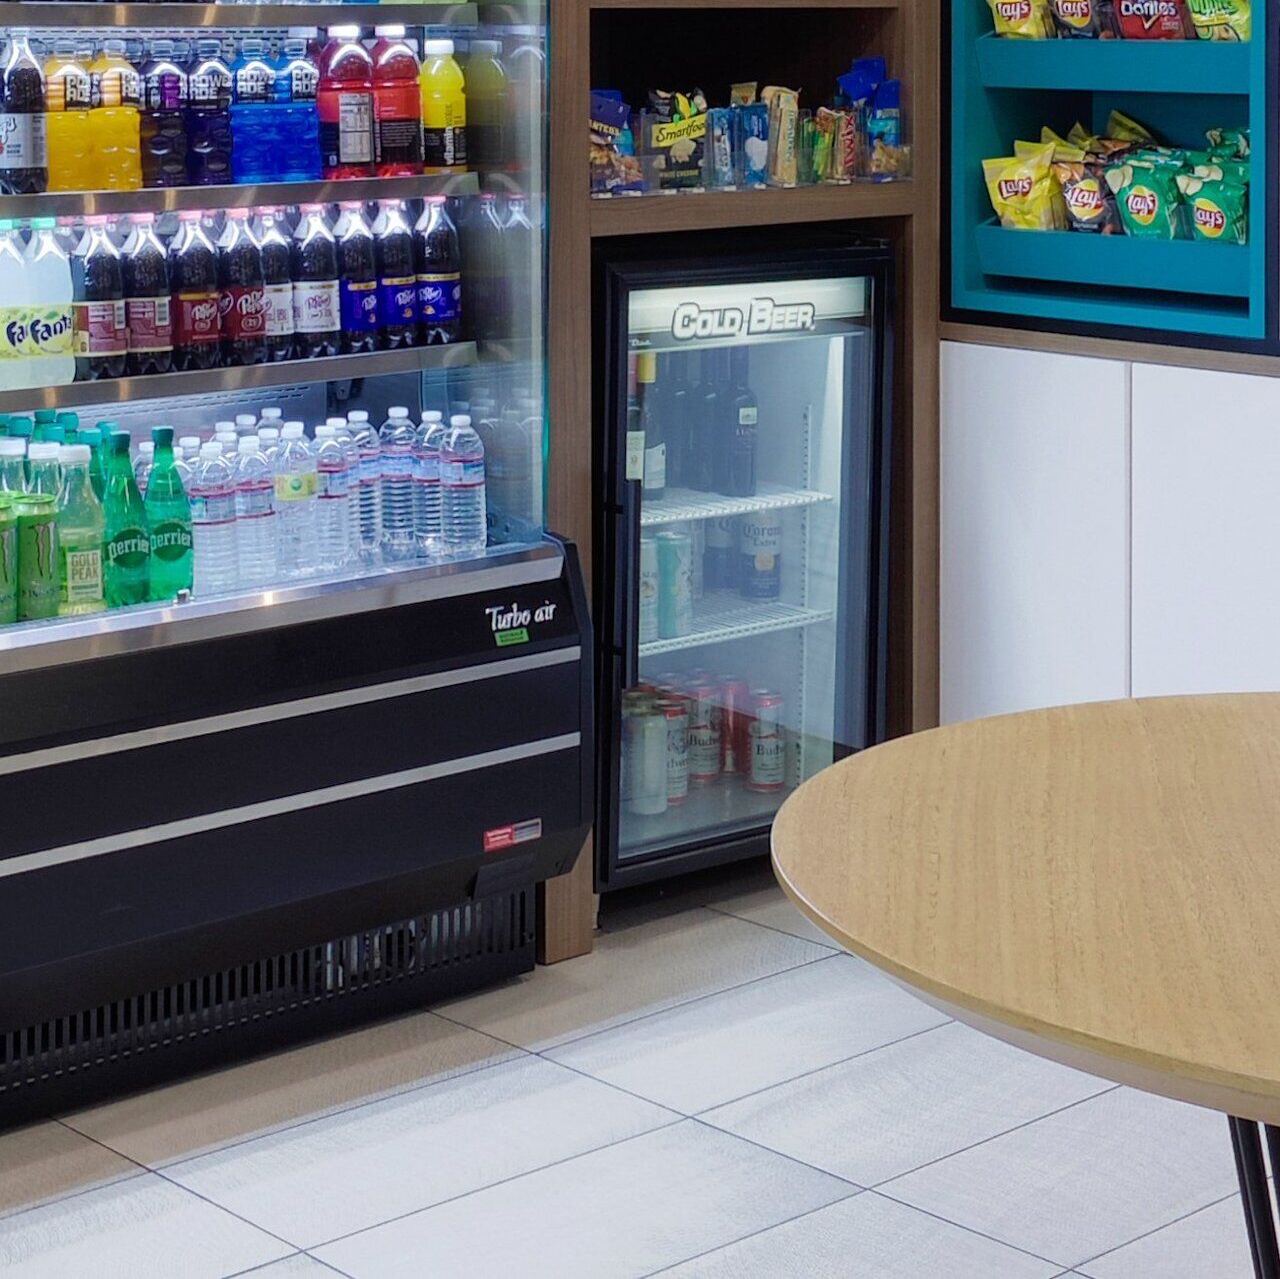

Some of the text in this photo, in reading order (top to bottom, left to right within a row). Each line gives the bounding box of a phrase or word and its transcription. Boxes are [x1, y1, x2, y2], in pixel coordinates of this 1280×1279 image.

[1121, 0, 1177, 16] Doritos
[672, 297, 815, 340] COLD BEER
[71, 553, 98, 566] GOLD
[71, 568, 98, 581] PEAK
[485, 600, 556, 631] Turbo air
